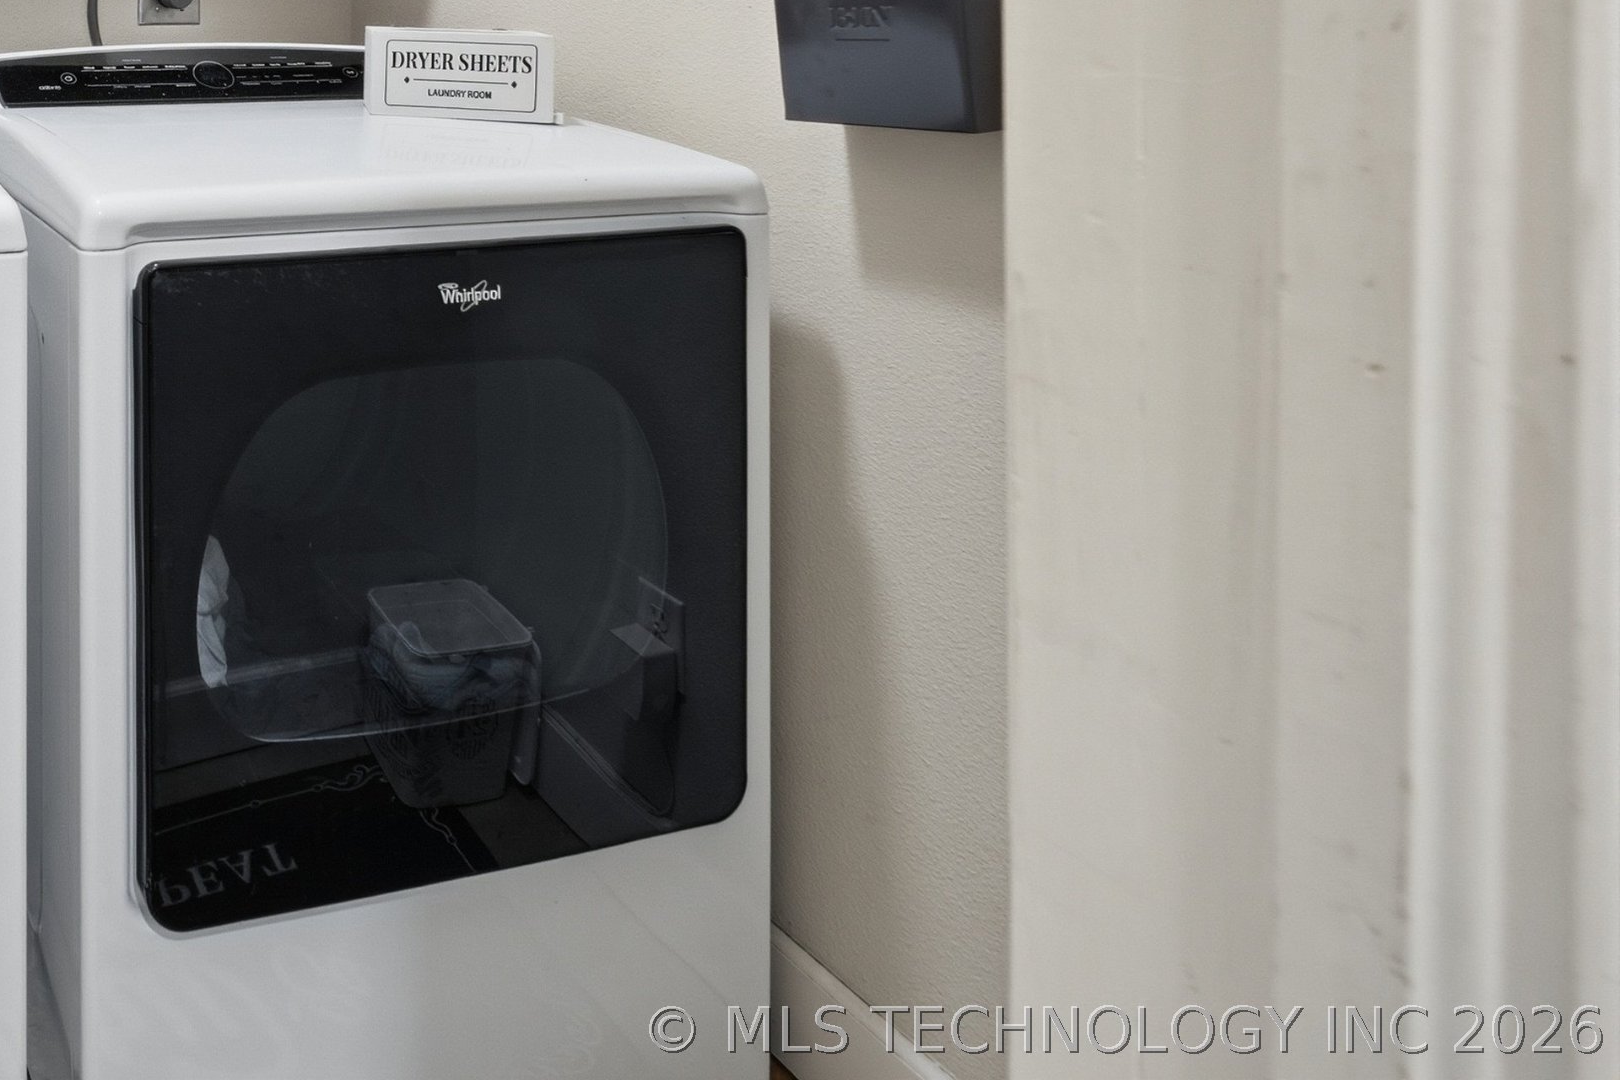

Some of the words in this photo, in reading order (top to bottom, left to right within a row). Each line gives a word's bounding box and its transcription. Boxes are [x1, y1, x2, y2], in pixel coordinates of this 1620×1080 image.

[391, 50, 454, 71] DRYER
[458, 53, 533, 74] SHEETS
[427, 88, 467, 99] LAUNDRY
[467, 90, 492, 99] ROOM
[438, 280, 502, 311] Whirlpool
